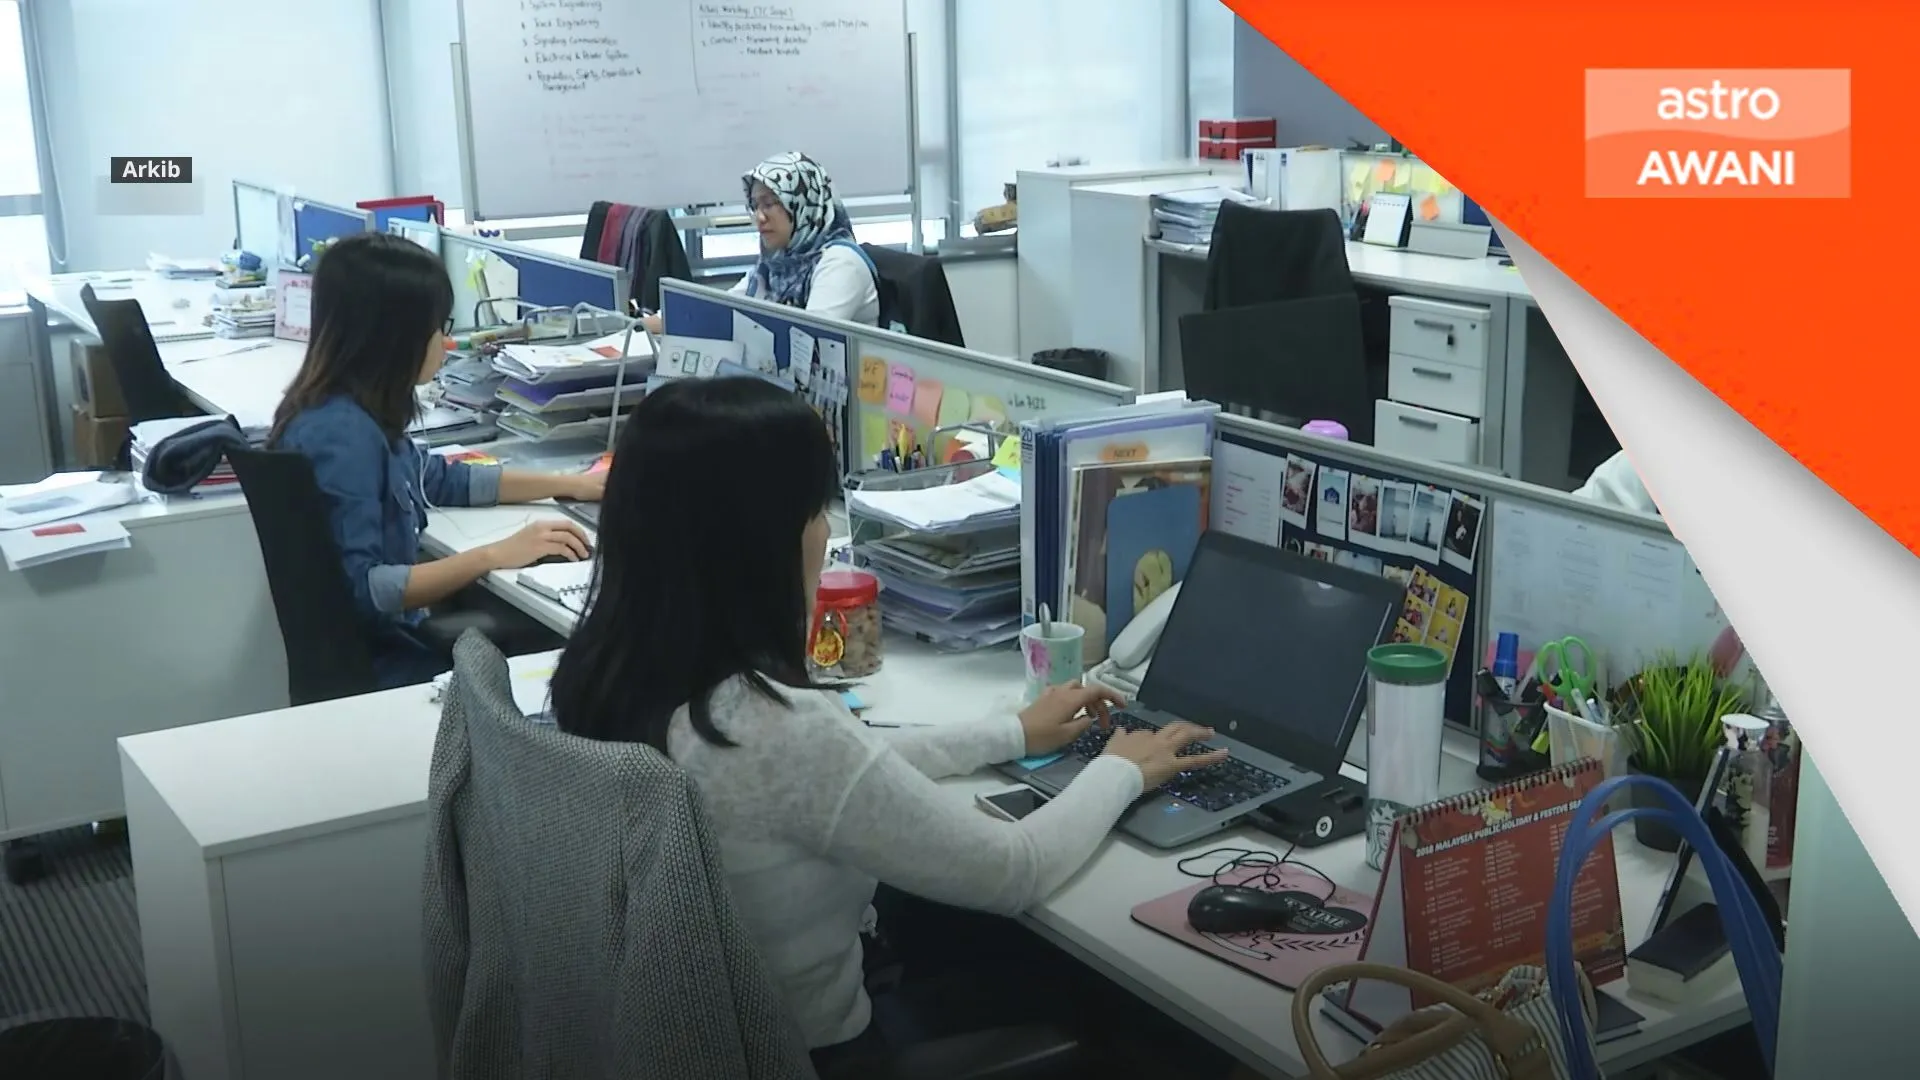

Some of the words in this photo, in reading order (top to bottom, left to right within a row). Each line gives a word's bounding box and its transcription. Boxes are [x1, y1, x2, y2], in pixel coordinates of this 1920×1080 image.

[1434, 832, 1474, 853] MALAYSIA
[1474, 824, 1501, 840] PUBLIC
[1501, 814, 1533, 831] HOLIDAY
[1539, 803, 1569, 821] FESTIVE
